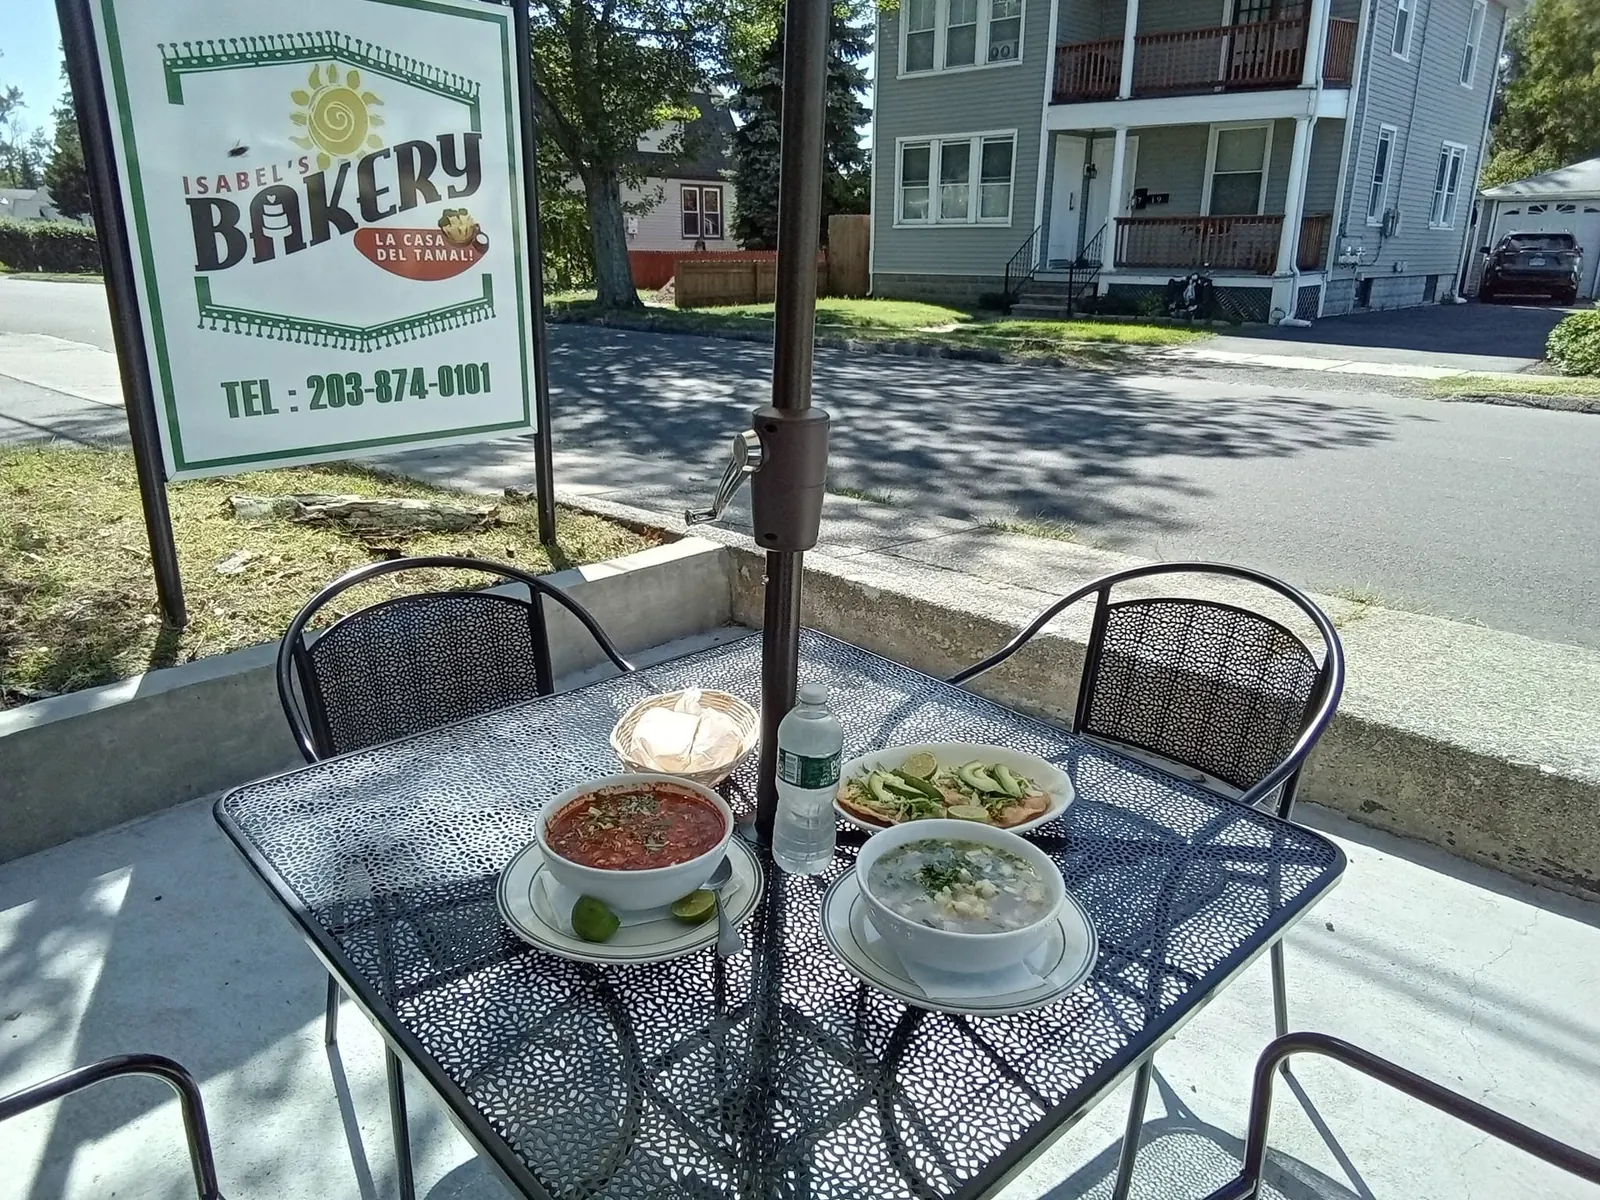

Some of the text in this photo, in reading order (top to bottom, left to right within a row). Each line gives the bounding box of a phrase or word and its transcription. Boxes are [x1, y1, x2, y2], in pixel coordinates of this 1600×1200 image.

[183, 156, 310, 195] ISABEL'S
[185, 133, 482, 272] BAKERY
[375, 233, 445, 247] LA CASA
[377, 249, 474, 262] DEL TAMAL!
[306, 362, 491, 411] 203-874-0101
